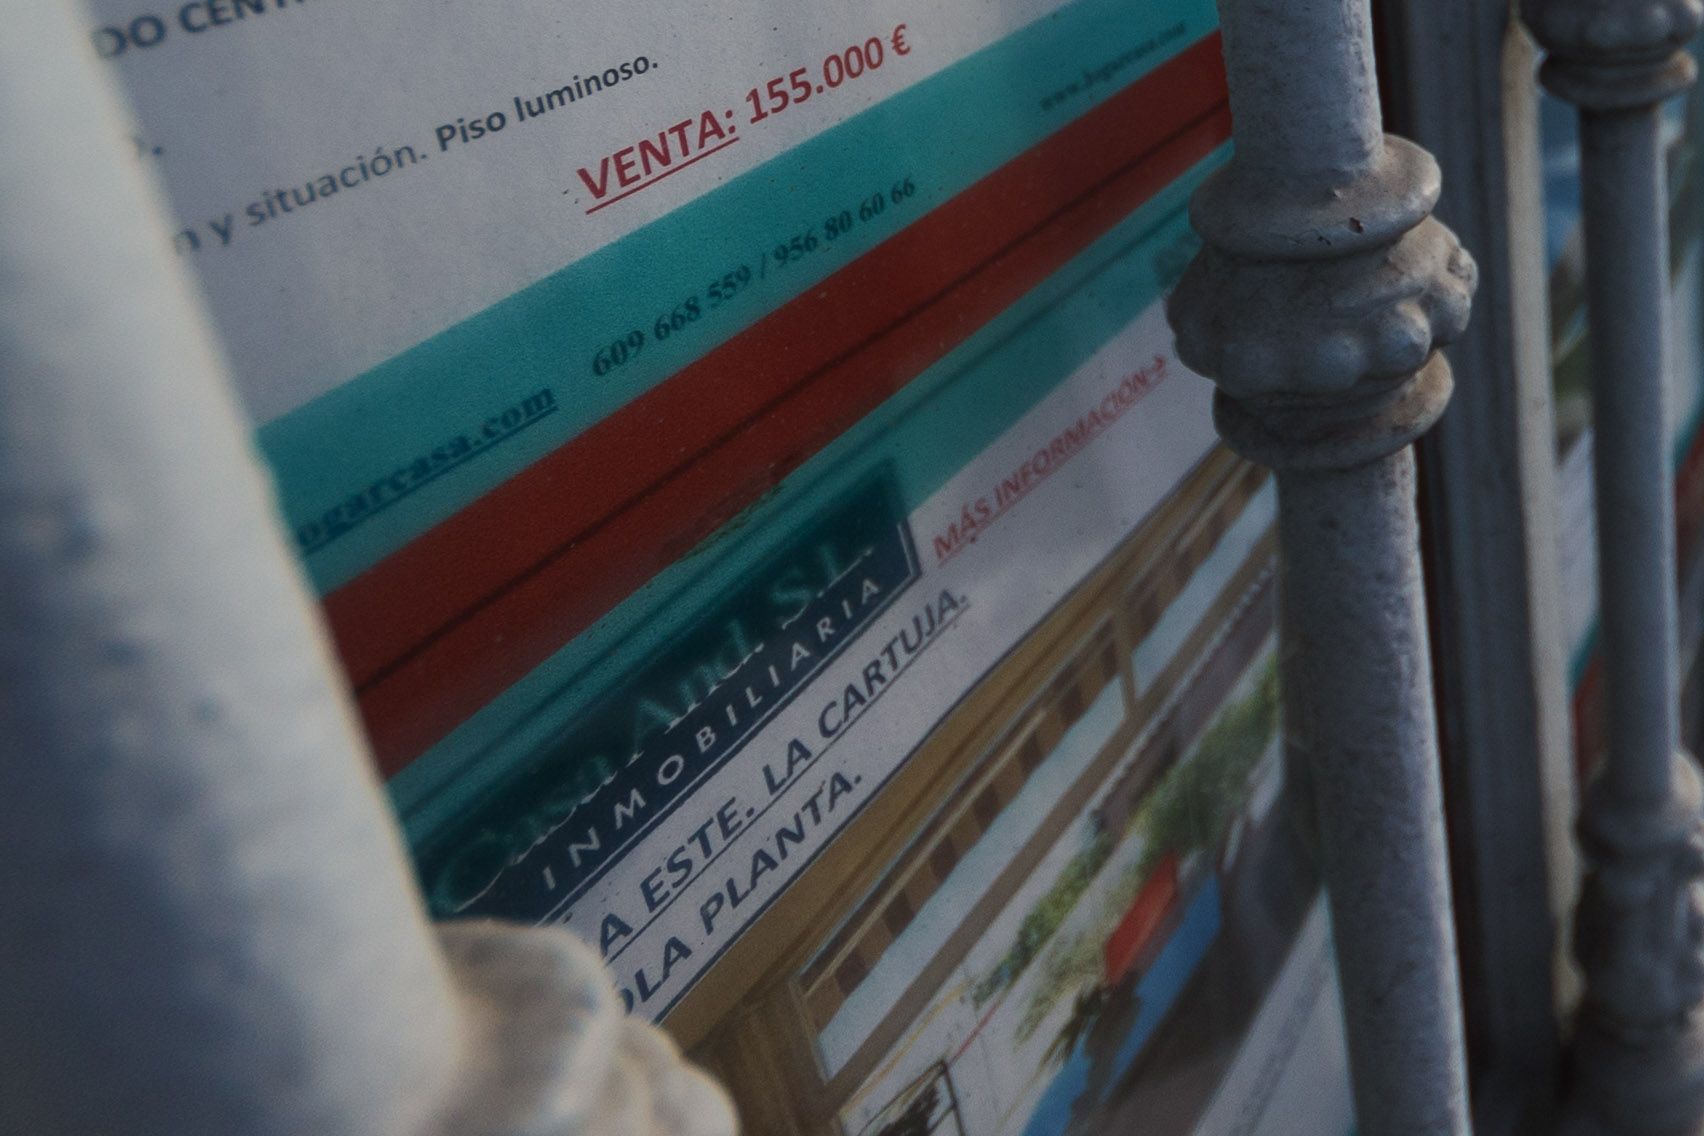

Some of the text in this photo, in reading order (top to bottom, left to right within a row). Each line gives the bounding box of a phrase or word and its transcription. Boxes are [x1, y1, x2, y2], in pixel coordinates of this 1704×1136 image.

[208, 214, 233, 248] y
[245, 142, 427, 227] situación.
[435, 110, 507, 152] Piso
[514, 53, 658, 122] luminoso.
[577, 23, 913, 207] VENTA: 155.000 €
[592, 175, 917, 378] 609 668 559 / 956 80 60 66
[932, 492, 992, 563] MÁS
[541, 575, 880, 891] INMOBILIARIA
[640, 796, 755, 914] ESTE.
[762, 738, 812, 796] LA
[818, 588, 969, 739] CARTUJA.
[700, 770, 862, 937] PLANTA.
